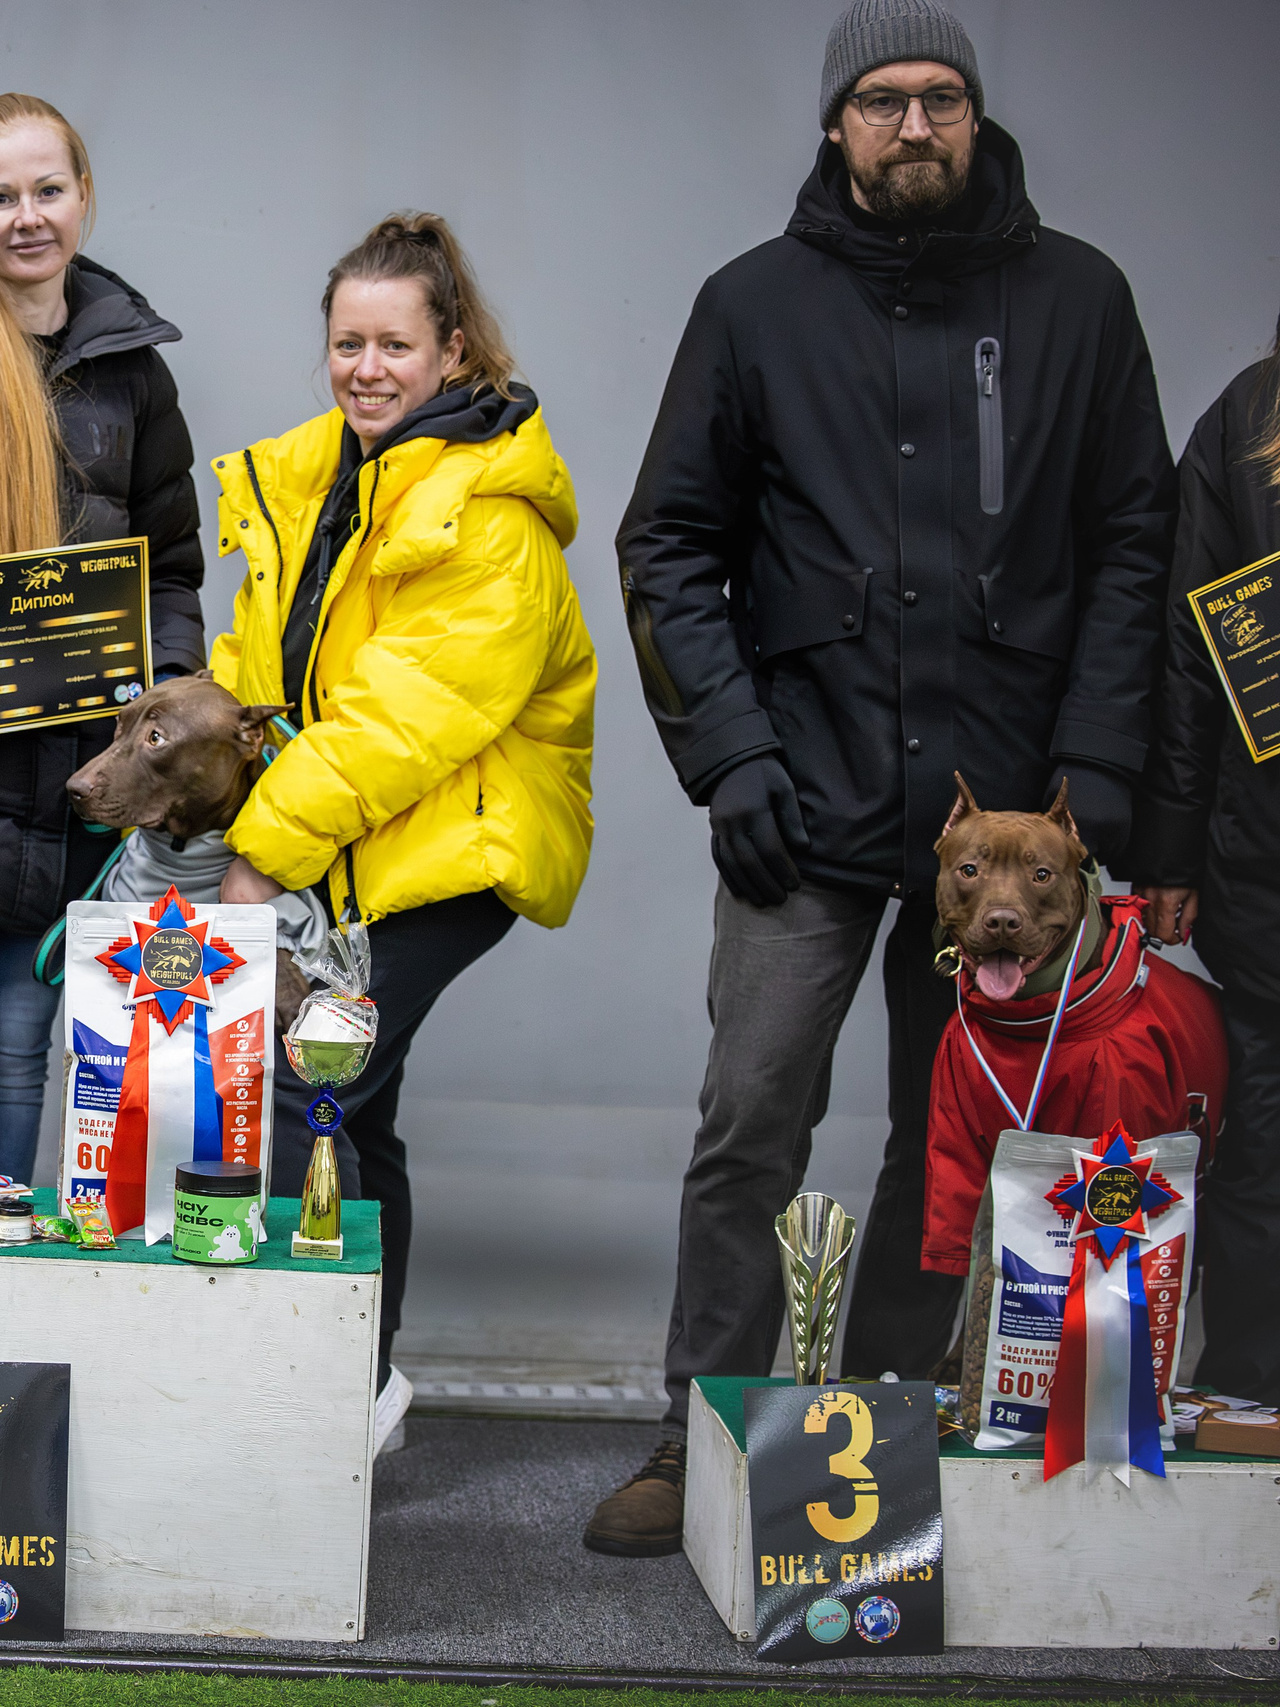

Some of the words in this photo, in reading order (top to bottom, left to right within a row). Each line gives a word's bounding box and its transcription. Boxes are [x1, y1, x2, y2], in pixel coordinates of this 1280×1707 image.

[80, 555, 137, 574] WEIGHTPULL
[1207, 594, 1236, 615] BULL
[1235, 576, 1273, 601] GAMES
[10, 592, 74, 614] Диплом
[153, 936, 170, 944] BULL
[171, 936, 193, 945] GAMES
[150, 969, 193, 981] WEIGHTPULL
[78, 1117, 114, 1129] СОДЕРЖ
[78, 1127, 98, 1137] МЯСА
[100, 1129, 109, 1138] НЕ
[1114, 1174, 1135, 1182] GAMES
[76, 1184, 84, 1197] 2
[1005, 1280, 1013, 1291] С
[1013, 1282, 1040, 1295] УТКОЙ
[1040, 1283, 1047, 1295] И
[1001, 1353, 1022, 1364] МЯСА
[1023, 1357, 1033, 1365] НЕ
[995, 1406, 1005, 1421] 2
[803, 1391, 880, 1543] 3
[760, 1554, 830, 1586] BULL
